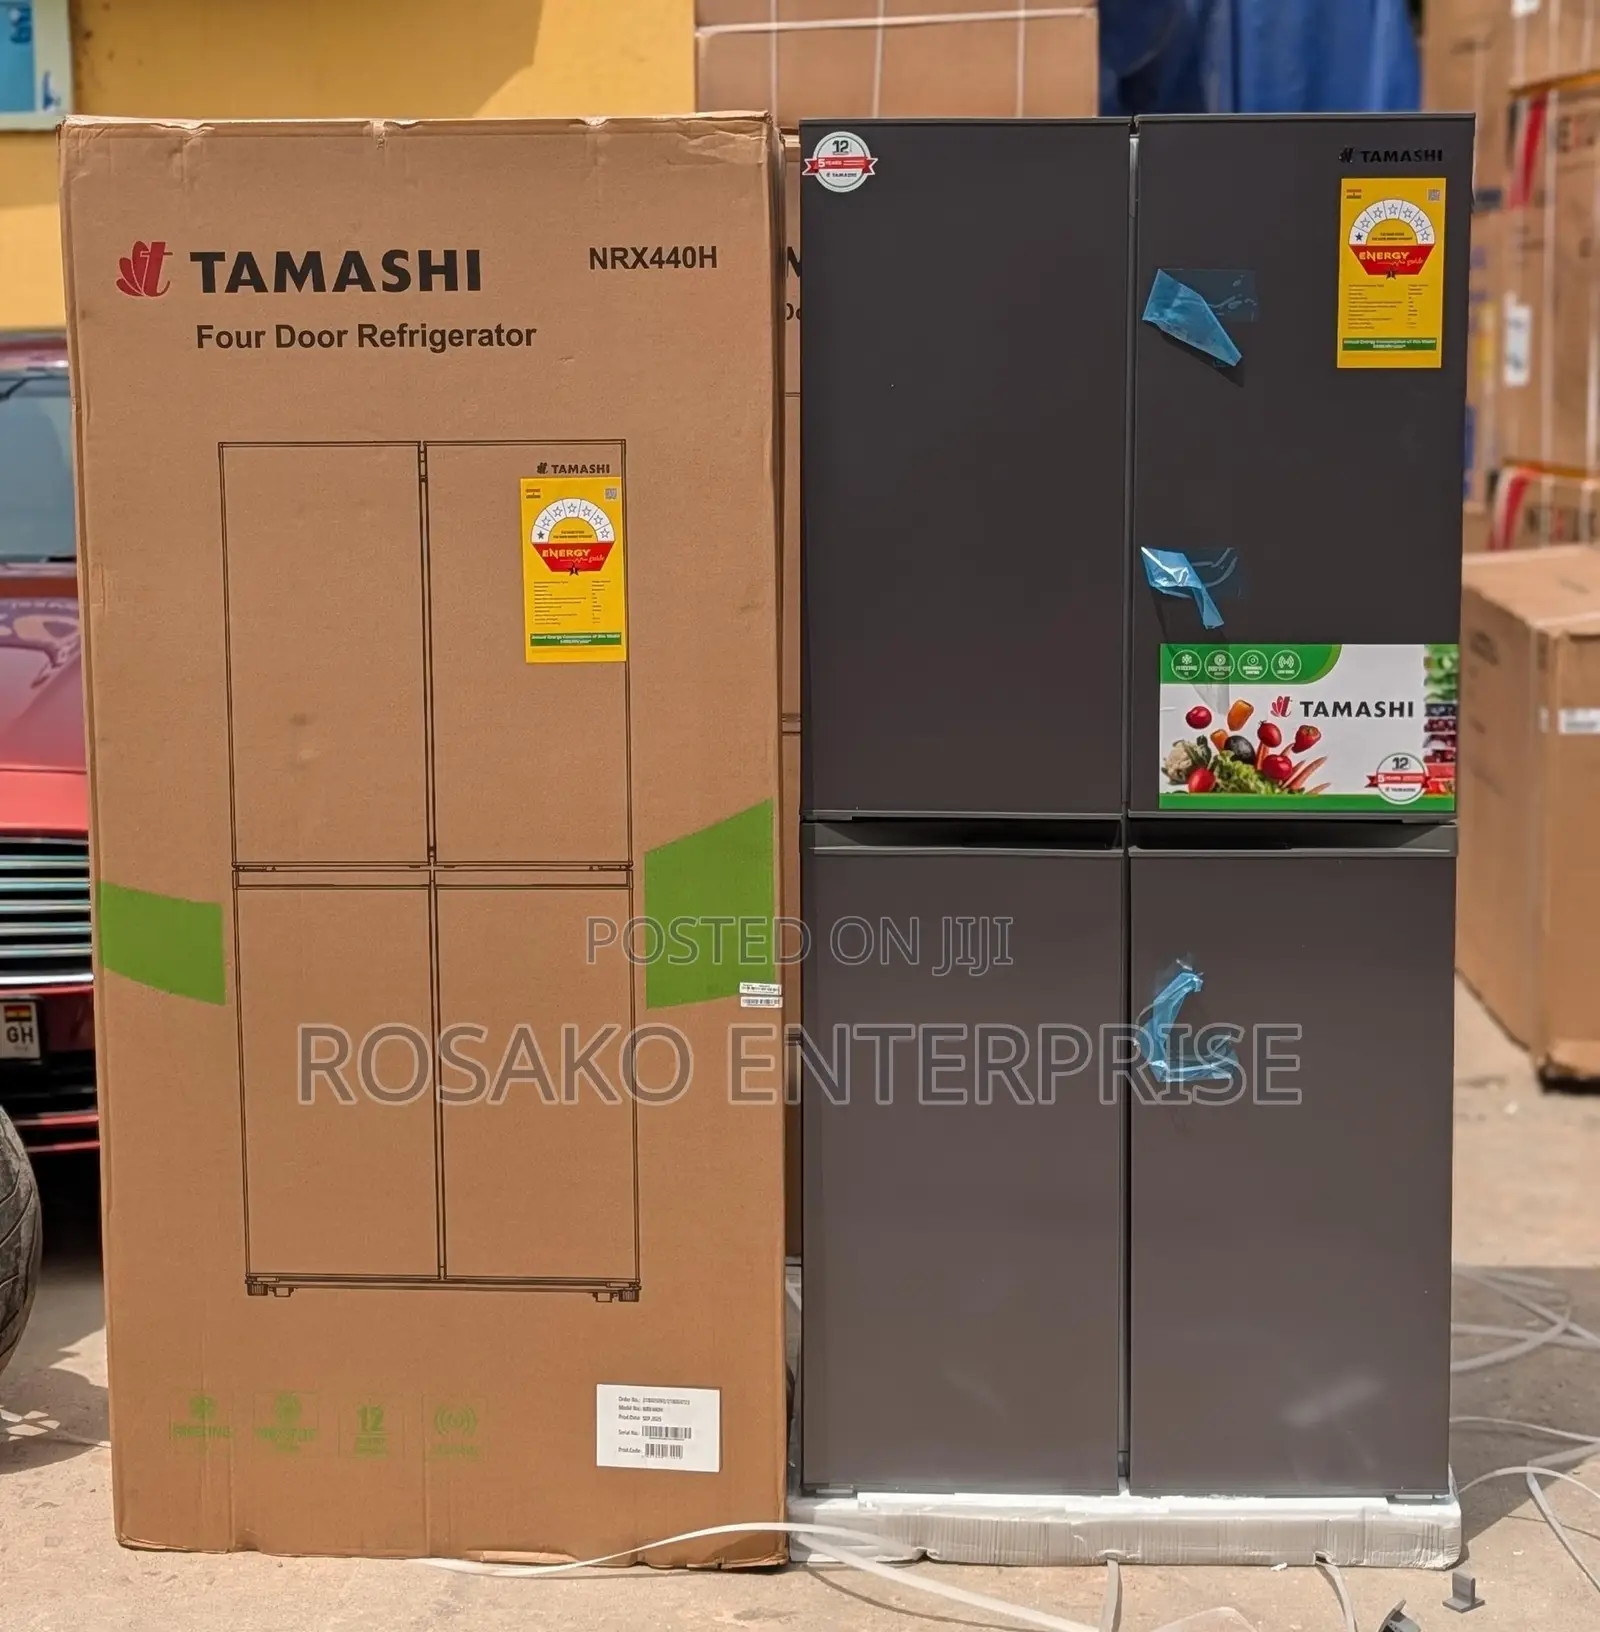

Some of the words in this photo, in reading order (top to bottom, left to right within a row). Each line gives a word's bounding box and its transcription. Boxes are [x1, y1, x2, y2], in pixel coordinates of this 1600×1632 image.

[831, 140, 849, 153] 12
[818, 158, 826, 168] 5
[1360, 149, 1443, 163] TAMASHI
[589, 245, 718, 270] NRX440H
[1358, 250, 1410, 263] ENERGY
[189, 249, 481, 294] TAMASHI
[196, 324, 266, 349] Four
[275, 324, 348, 348] Door
[357, 322, 537, 354] Refrigerator
[551, 464, 610, 474] TAMASHI
[541, 548, 591, 560] ENERGY
[1300, 701, 1414, 718] TAMASHI
[1392, 757, 1409, 769] 12
[6, 1026, 34, 1044] GH
[358, 1405, 385, 1432] 12
